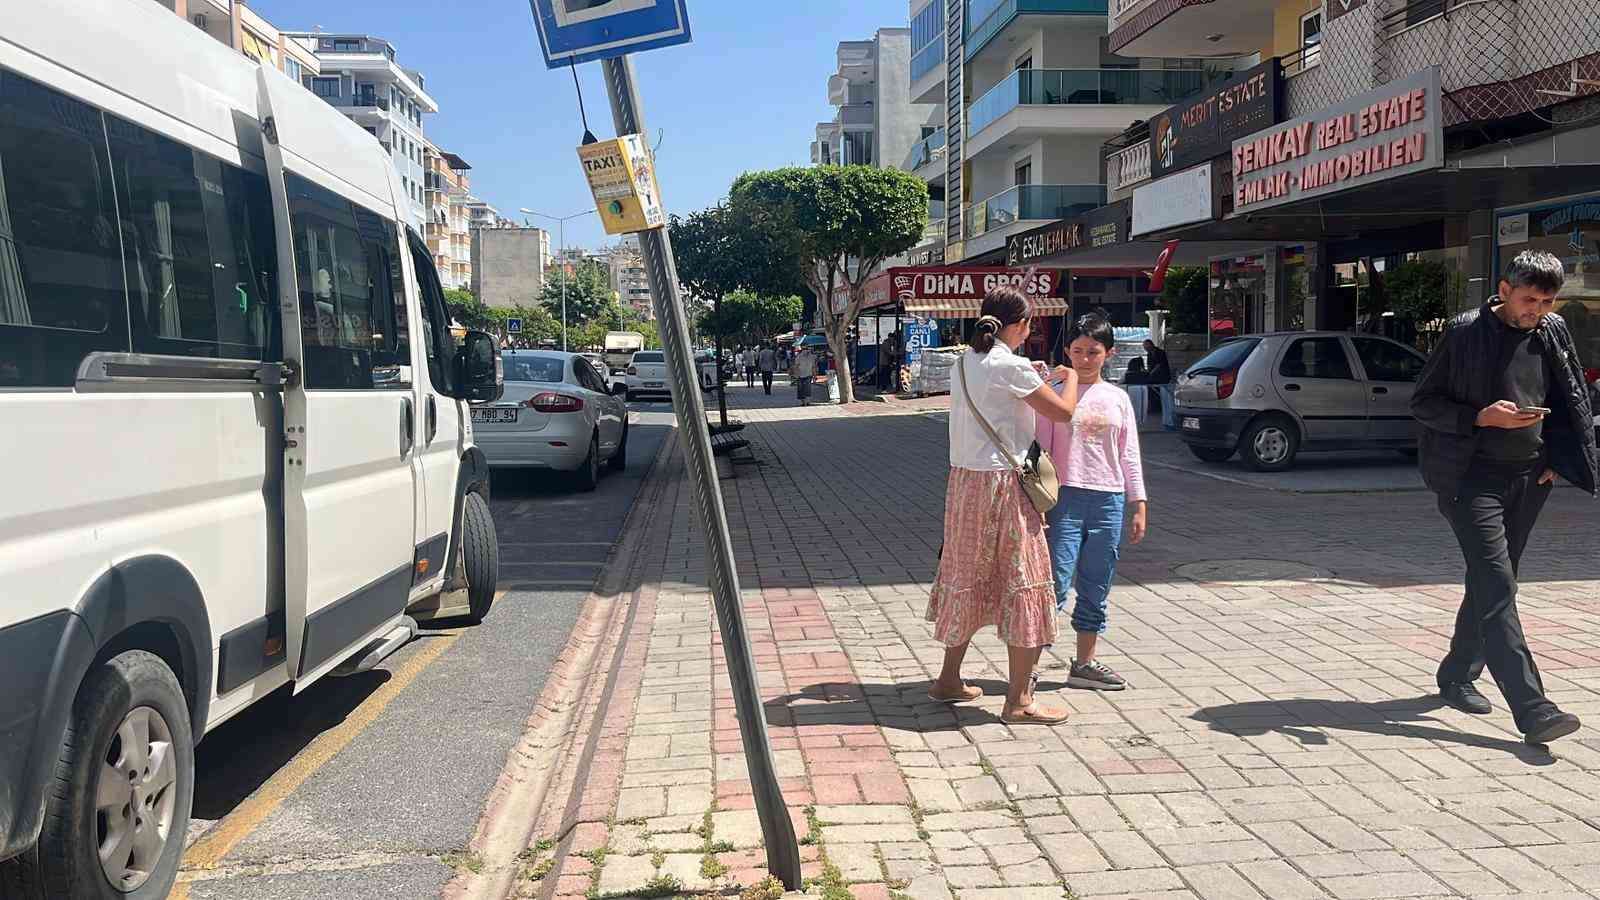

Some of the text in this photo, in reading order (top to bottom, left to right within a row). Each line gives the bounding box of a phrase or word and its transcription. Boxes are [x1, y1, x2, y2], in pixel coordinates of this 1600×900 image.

[1181, 96, 1216, 128] MERIT
[1218, 72, 1266, 113] ESTATE
[1316, 113, 1356, 150] REAL
[1359, 88, 1425, 137] ESTATE
[583, 155, 615, 171] TAXI
[1236, 170, 1289, 208] EMLAK
[1299, 132, 1425, 191] IMMOBILIEN
[1022, 232, 1045, 259] ESKA
[983, 274, 1051, 295] GROSS
[910, 334, 931, 347] SU
[503, 410, 515, 419] 94
